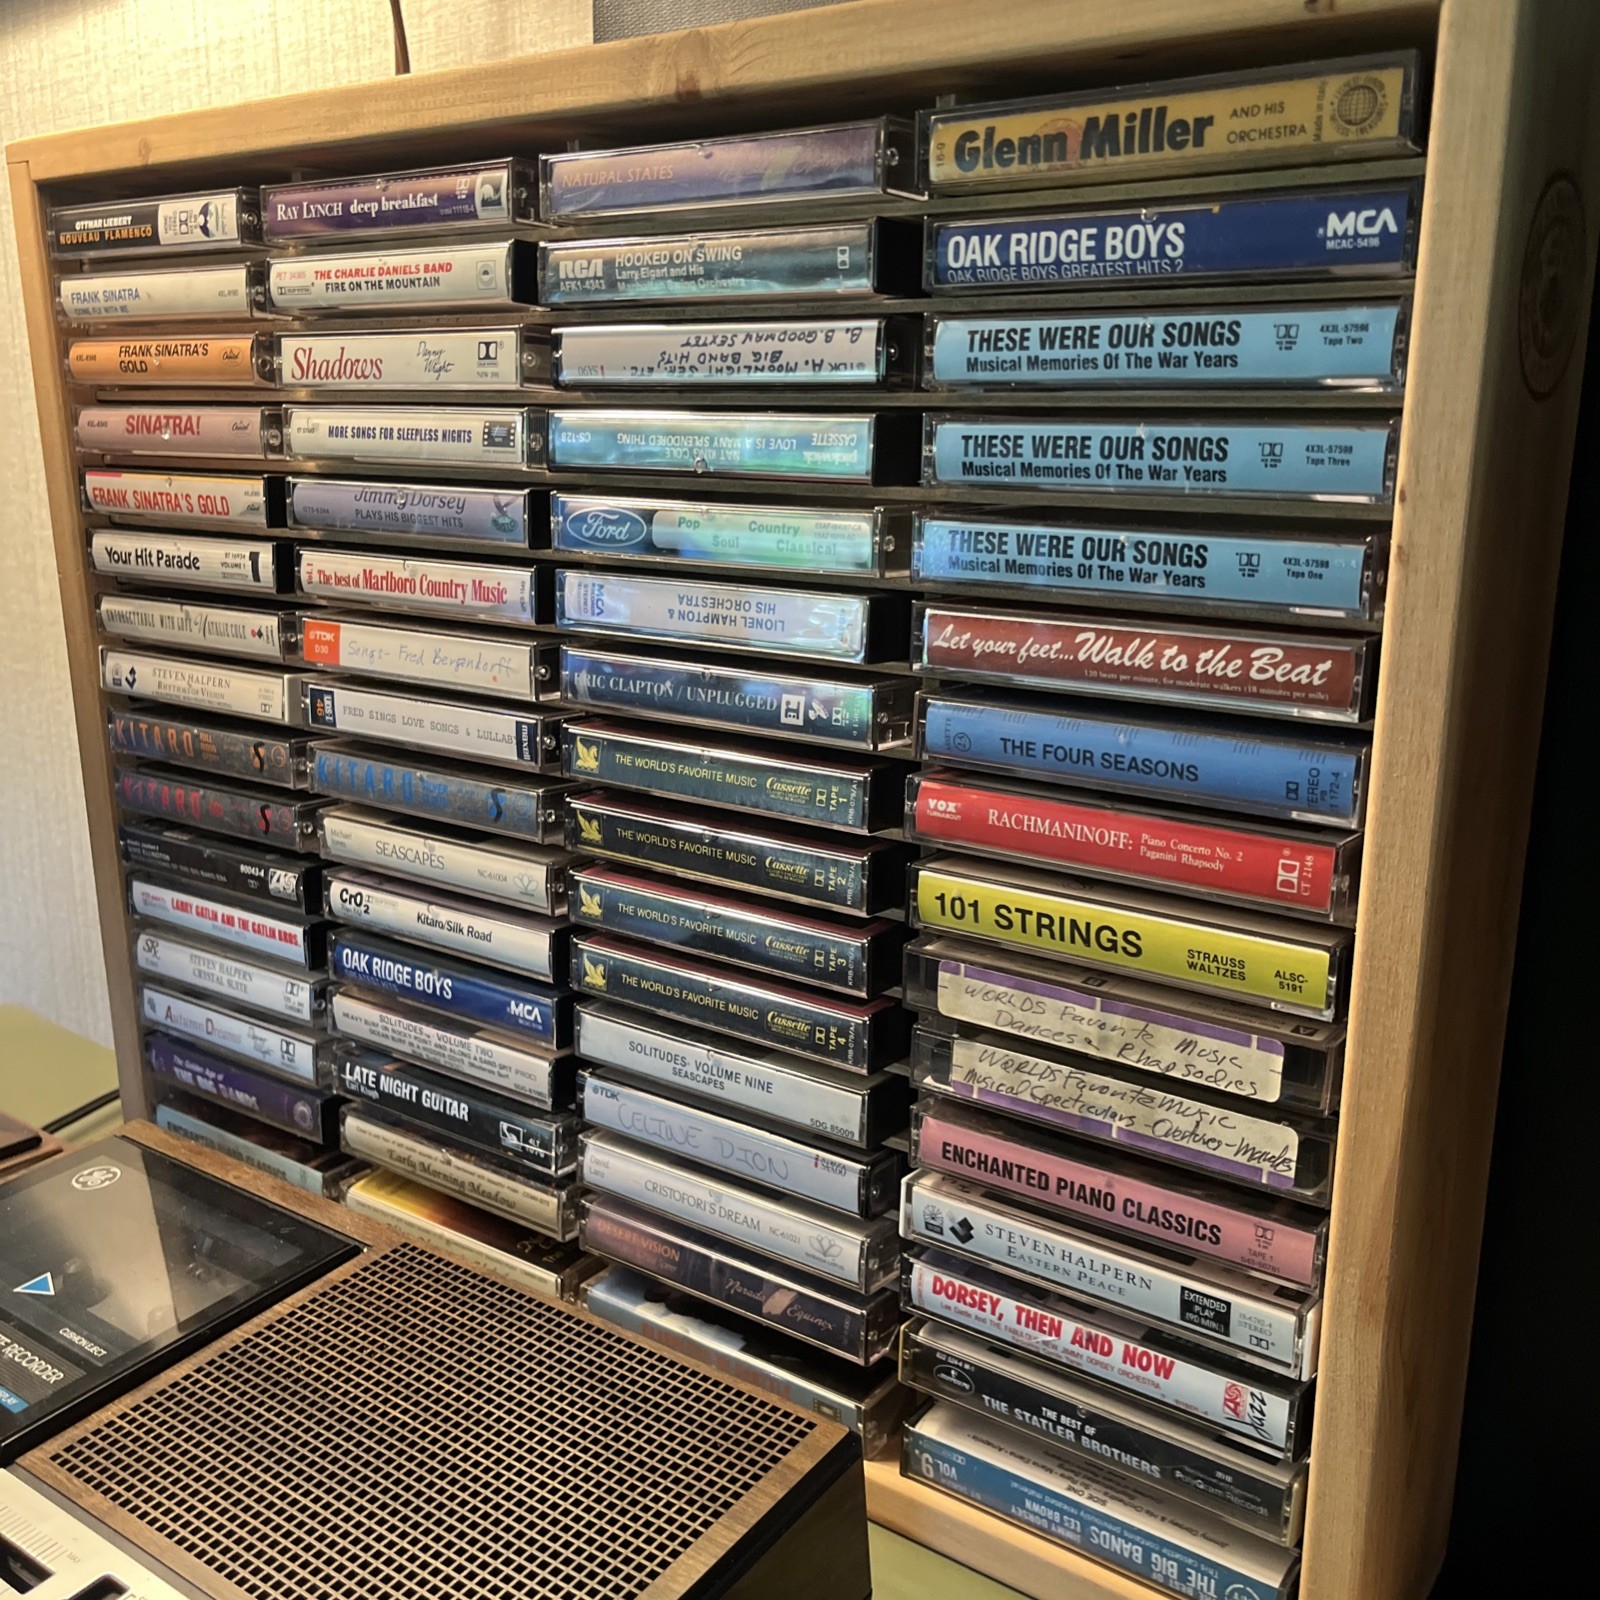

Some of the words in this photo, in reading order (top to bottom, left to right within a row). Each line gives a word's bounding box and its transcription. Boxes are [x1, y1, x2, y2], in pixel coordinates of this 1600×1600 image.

[1230, 103, 1260, 120] AND
[1264, 101, 1285, 116] HIS
[954, 125, 1067, 173] Glenn
[1080, 106, 1214, 161] Miller
[1226, 124, 1307, 145] ORCHESTRA
[562, 171, 624, 187] NATURAL
[627, 165, 674, 182] STATES
[277, 205, 299, 221] RAY
[302, 201, 342, 220] LYNCH
[350, 198, 378, 217] deep
[382, 192, 438, 212] breakfast
[75, 218, 102, 231] OTTMAR
[103, 216, 133, 228] LIEBERT
[1327, 208, 1398, 237] MCA
[60, 232, 100, 245] NOUVEAU
[104, 226, 152, 240] FLAMENCO
[947, 234, 1001, 269] OAK
[1009, 228, 1097, 266] RIDGE
[1104, 222, 1186, 260] BOYS
[559, 260, 603, 279] RCA
[615, 250, 670, 268] HOOKED
[672, 249, 693, 264] ON
[696, 246, 742, 262] SWING
[314, 270, 332, 280] THE
[334, 266, 376, 280] CHARLIE
[378, 264, 420, 277] DANIELS
[423, 262, 452, 274] BAND
[325, 281, 346, 294] FIRE
[348, 281, 362, 292] ON
[364, 280, 384, 291] THE
[386, 276, 440, 290] MOUNTAIN
[967, 329, 1031, 352] THESE
[1038, 326, 1101, 350] WERE
[1108, 324, 1154, 348] OUR
[1161, 320, 1242, 347] SONGS
[118, 344, 152, 358] FRANK
[154, 342, 209, 357] SINATRA'S
[698, 352, 742, 365] BAND
[752, 350, 783, 364] BIG
[966, 355, 1021, 372] Musical
[1026, 353, 1099, 372] Memories
[1103, 353, 1120, 370] Of
[1125, 352, 1153, 370] The
[1158, 352, 1190, 369] War
[1194, 351, 1238, 368] Years
[119, 360, 148, 374] GOLD
[291, 346, 383, 380] Shadows
[125, 414, 201, 436] SINATRA!
[328, 425, 348, 440] MORE
[350, 426, 376, 440] SONGS
[379, 426, 394, 440] FOR
[396, 428, 439, 442] SLEEPLESS
[442, 428, 472, 444] NIGHTS
[810, 433, 857, 446] CASSETTE
[92, 486, 128, 510] FRANK
[132, 490, 194, 514] SINATRA'S
[197, 494, 230, 516] GOLD
[354, 508, 383, 521] PLAYS
[384, 510, 400, 522] HIS
[401, 512, 440, 527] BIGGEST
[442, 515, 464, 528] HITS
[581, 510, 630, 542] Ford
[678, 516, 701, 532] Pop
[748, 520, 800, 538] Country
[105, 546, 132, 566] Your
[134, 547, 154, 567] Hit
[156, 549, 200, 571] Parade
[712, 536, 740, 550] Soul
[776, 539, 838, 556] Classical
[317, 568, 332, 586] The
[334, 571, 350, 588] best
[352, 574, 360, 588] of
[362, 569, 416, 595] Marlboro
[419, 574, 468, 605] Country
[471, 580, 508, 605] Music
[677, 594, 752, 612] ORCHESTRA
[756, 602, 776, 615] HIS
[678, 610, 738, 628] HAMPTON
[742, 616, 785, 632] LIONEL
[933, 624, 970, 650] Let
[972, 636, 1016, 658] your
[1075, 632, 1156, 671] Walk
[1160, 644, 1190, 672] to
[1195, 644, 1242, 680] the
[1250, 648, 1332, 687] Beat
[610, 676, 673, 698] CLAPTON
[686, 686, 778, 712] UNPLUGGED
[616, 754, 632, 766] THE
[634, 756, 676, 774] WORLD'S
[678, 765, 723, 782] FAVORITE
[726, 773, 758, 788] MUSIC
[1000, 737, 1036, 758] THE
[1042, 744, 1095, 768] FOUR
[1100, 753, 1199, 783] SEASONS
[766, 776, 812, 796] Cassette
[830, 784, 840, 812] TAPE
[988, 809, 1133, 852] RACHMANINOFF:
[376, 840, 445, 871] SEASCAPES
[1141, 832, 1166, 848] Piano
[1170, 836, 1212, 856] Concerto
[1140, 846, 1177, 866] Paganini
[1181, 850, 1225, 873] Rhapsody
[252, 918, 276, 940] GATLIN
[416, 912, 464, 936] Kitaro/Silk
[466, 925, 492, 943] Road
[934, 892, 980, 925] 101
[994, 904, 1143, 958] STRINGS
[1187, 950, 1246, 970] STRAUSS
[1187, 960, 1246, 982] WALTZES
[342, 948, 370, 974] OAK
[372, 957, 412, 988] RIDGE
[415, 973, 453, 1000] BOYS
[510, 1000, 542, 1024] MCA
[629, 1040, 686, 1068] SOLITUDES
[694, 1060, 741, 1084] VOLUME
[744, 1075, 774, 1094] NINE
[672, 1066, 725, 1091] SEASCAPES
[345, 1062, 376, 1088] LATE
[380, 1071, 419, 1102] NIGHT
[422, 1090, 469, 1122] GUITAR
[942, 1140, 1050, 1194] ENCHANTED
[1056, 1176, 1116, 1212] PIANO
[1122, 1198, 1222, 1246] CLASSICS
[718, 1203, 761, 1233] DREAM
[985, 1222, 1054, 1258] STEVEN
[1060, 1248, 1153, 1292] HALPERN
[1007, 1244, 1072, 1278] EASTERN
[1077, 1270, 1126, 1297] PEACE
[932, 1274, 1004, 1321] DORSEY,
[1015, 1305, 1062, 1340] THEN
[1070, 1327, 1114, 1358] AND
[1122, 1346, 1176, 1382] NOW
[2, 1343, 64, 1384] RECORDER
[1014, 1406, 1076, 1442] STATLER
[1081, 1434, 1162, 1480] BROTHERS
[1089, 1535, 1144, 1565] BANDS
[1150, 1553, 1179, 1578] BIG
[1186, 1573, 1218, 1599] THE
